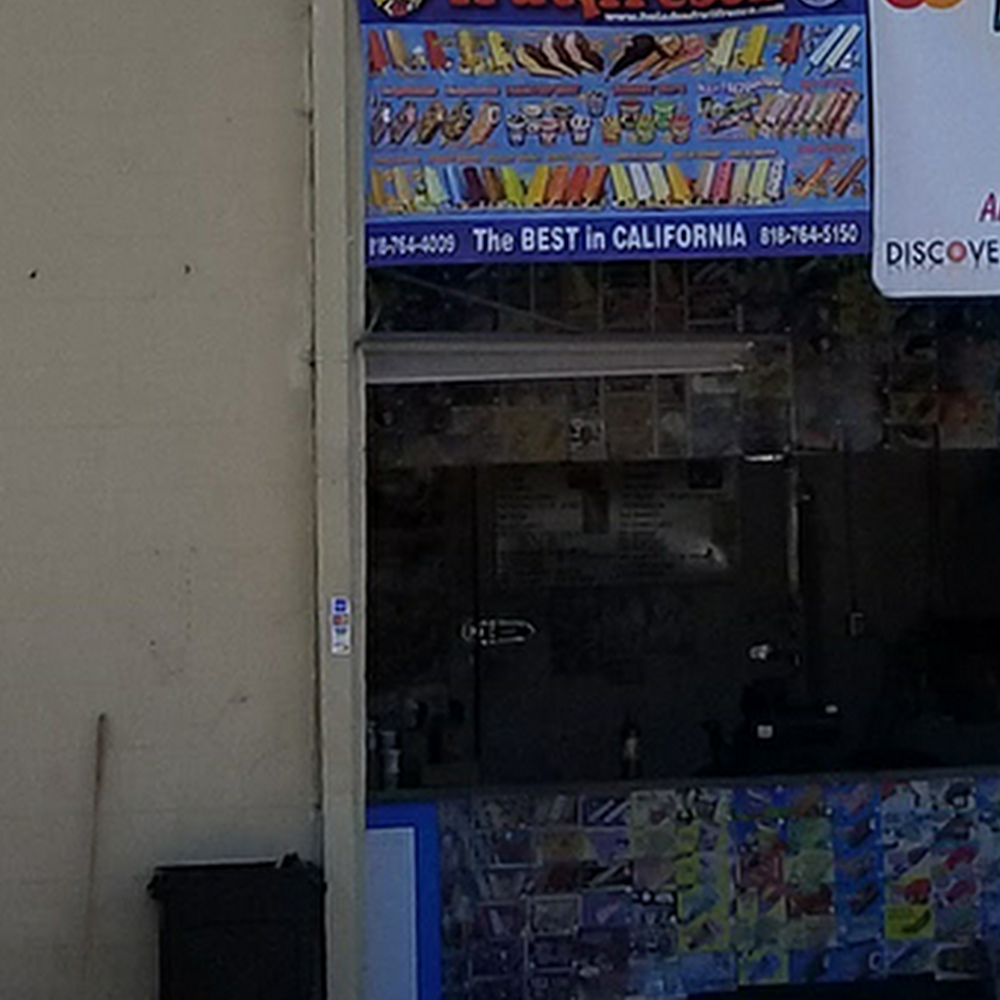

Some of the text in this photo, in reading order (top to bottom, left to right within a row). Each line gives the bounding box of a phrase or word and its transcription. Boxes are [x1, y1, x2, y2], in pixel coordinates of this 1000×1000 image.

[472, 221, 747, 252] The BEST in CALIFORNIA
[759, 223, 859, 246] 818-764-5150
